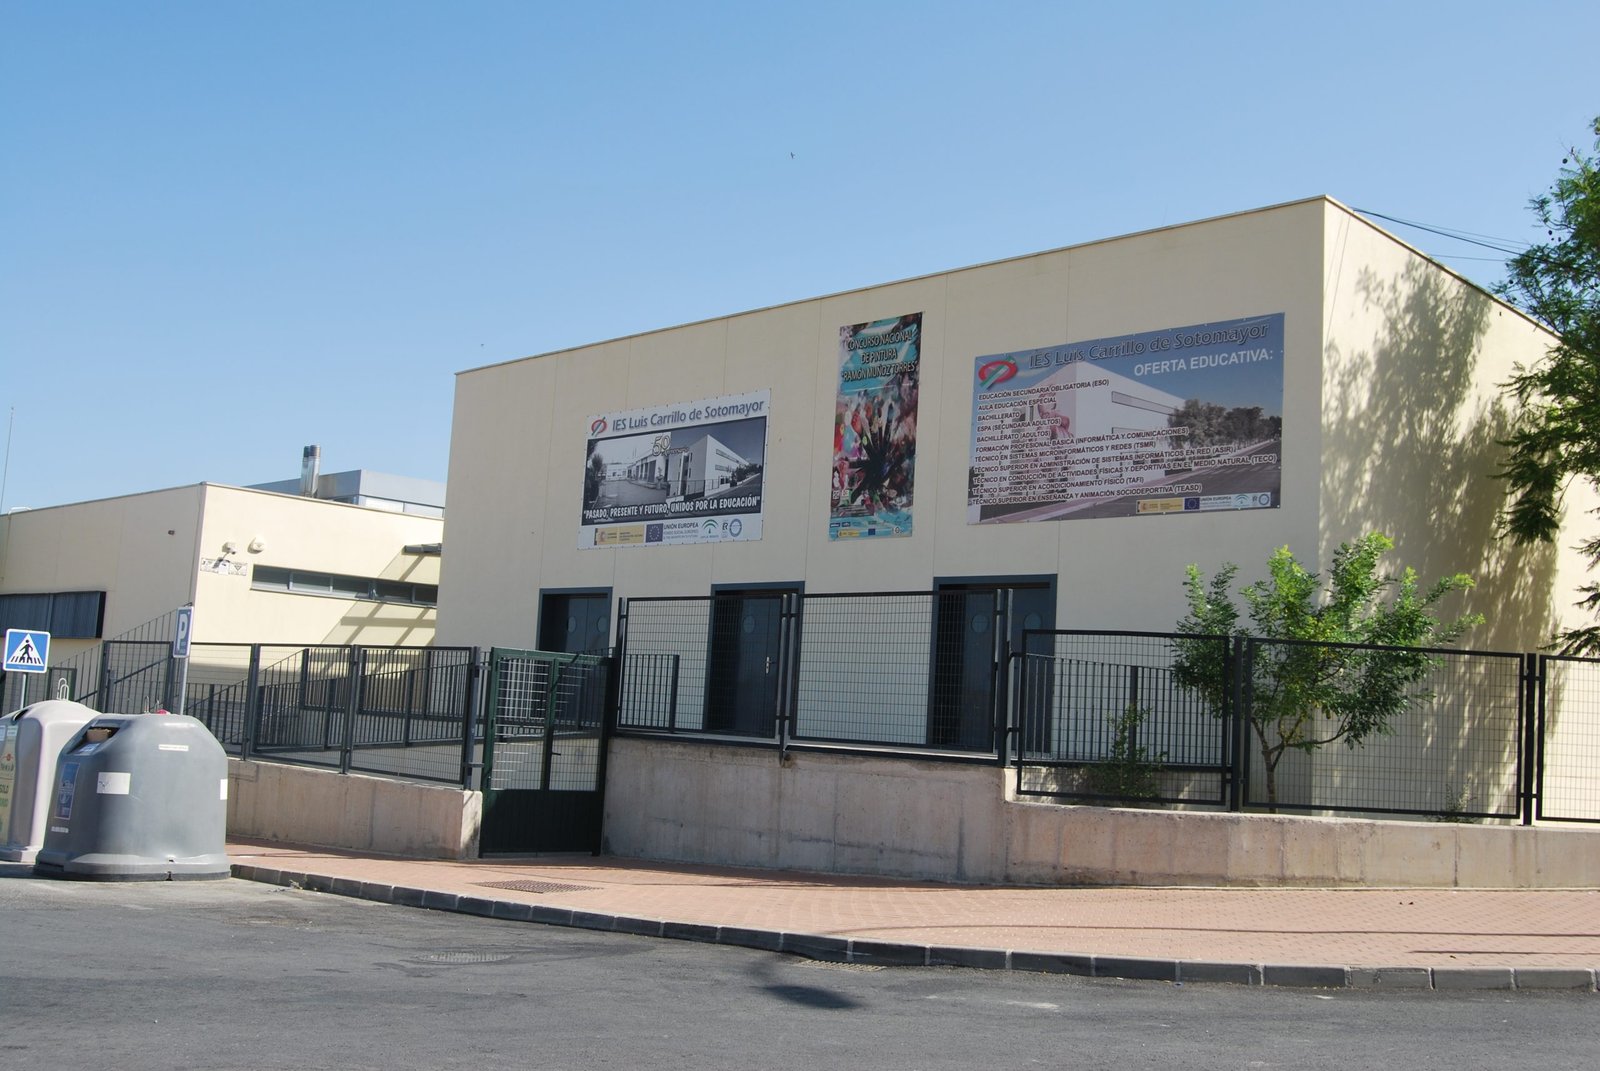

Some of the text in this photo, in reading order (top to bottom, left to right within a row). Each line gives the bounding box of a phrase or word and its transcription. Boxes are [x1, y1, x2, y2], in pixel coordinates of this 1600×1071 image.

[847, 330, 912, 351] CONCURSO NACIONAL
[1028, 323, 1269, 370] IES Luis Carrillo de Sotomayor
[861, 348, 897, 364] DE PINTURA
[1134, 348, 1274, 377] OFERTA EDUCATIVA:
[979, 391, 1012, 401] EDUCACIÓN
[1012, 387, 1050, 398] SECUNDARIA
[1050, 382, 1092, 392] OBLIGATORIA
[1092, 379, 1110, 388] (ESO)
[978, 396, 1057, 411] AULA EDUCACIÓN ESPECIAL
[612, 400, 765, 433] IES Luis Carrillo de Sotomayor
[977, 412, 1020, 422] BACHILLERATO
[977, 418, 1061, 433] ESPA (SECUNDARIA ADULTOS)
[976, 430, 1051, 443] BACHILLERATO (ADULTOS)
[976, 444, 1009, 453] FORMACIÓN
[1010, 441, 1051, 450] PROFESIONAL
[1052, 438, 1075, 447] BÁSICA
[1075, 434, 1120, 445] (INFORMÁTICA
[1126, 427, 1190, 439] COMUNICACIONES)
[974, 465, 999, 473] TÉCNICO
[1000, 463, 1029, 472] SUPERIOR
[1039, 457, 1091, 468] ADMINISTRACIÓN
[1101, 454, 1133, 463] SISTEMAS
[1134, 450, 1185, 461] INFORMÁTICOS
[1196, 447, 1212, 455] RED
[975, 454, 1000, 463] TÉCNICO
[1009, 451, 1039, 460] SISTEMAS
[1039, 445, 1104, 458] MICROINFORMÁTICOS
[1111, 443, 1133, 451] REDES
[1133, 441, 1157, 450] (TSMR)
[974, 475, 998, 484] TÉCNICO
[1008, 471, 1048, 482] CONDUCCIÓN
[1057, 469, 1098, 478] ACTIVIDADES
[1099, 466, 1123, 475] FÍSICAS
[1130, 462, 1172, 473] DEPORTIVAS
[1183, 460, 1193, 468] EL
[1194, 459, 1217, 468] MEDIO
[1217, 456, 1250, 466] NATURAL
[1251, 454, 1278, 465] (TECO)
[972, 497, 997, 506] TÉCNICO
[997, 495, 1028, 504] SUPERIOR
[1037, 492, 1074, 501] ENSEÑANZA
[1079, 490, 1115, 499] ANIMACIÓN
[1116, 485, 1174, 496] SOCIODEPORTIVA
[1174, 484, 1203, 494] (TEASD)
[973, 487, 998, 495] TÉCNICO
[998, 485, 1028, 494] SUPERIOR
[1037, 480, 1103, 490] ACONDICIONAMIENTO
[1104, 477, 1125, 485] FÍSICO
[1126, 476, 1145, 485] (TAFI)
[583, 494, 761, 520] "PASADO, PRESENTE Y FUTURO, UNIDOS POR LA EDUCACIÓN"
[663, 521, 699, 530] UNIÓN EUROPEA
[177, 613, 189, 651] P
